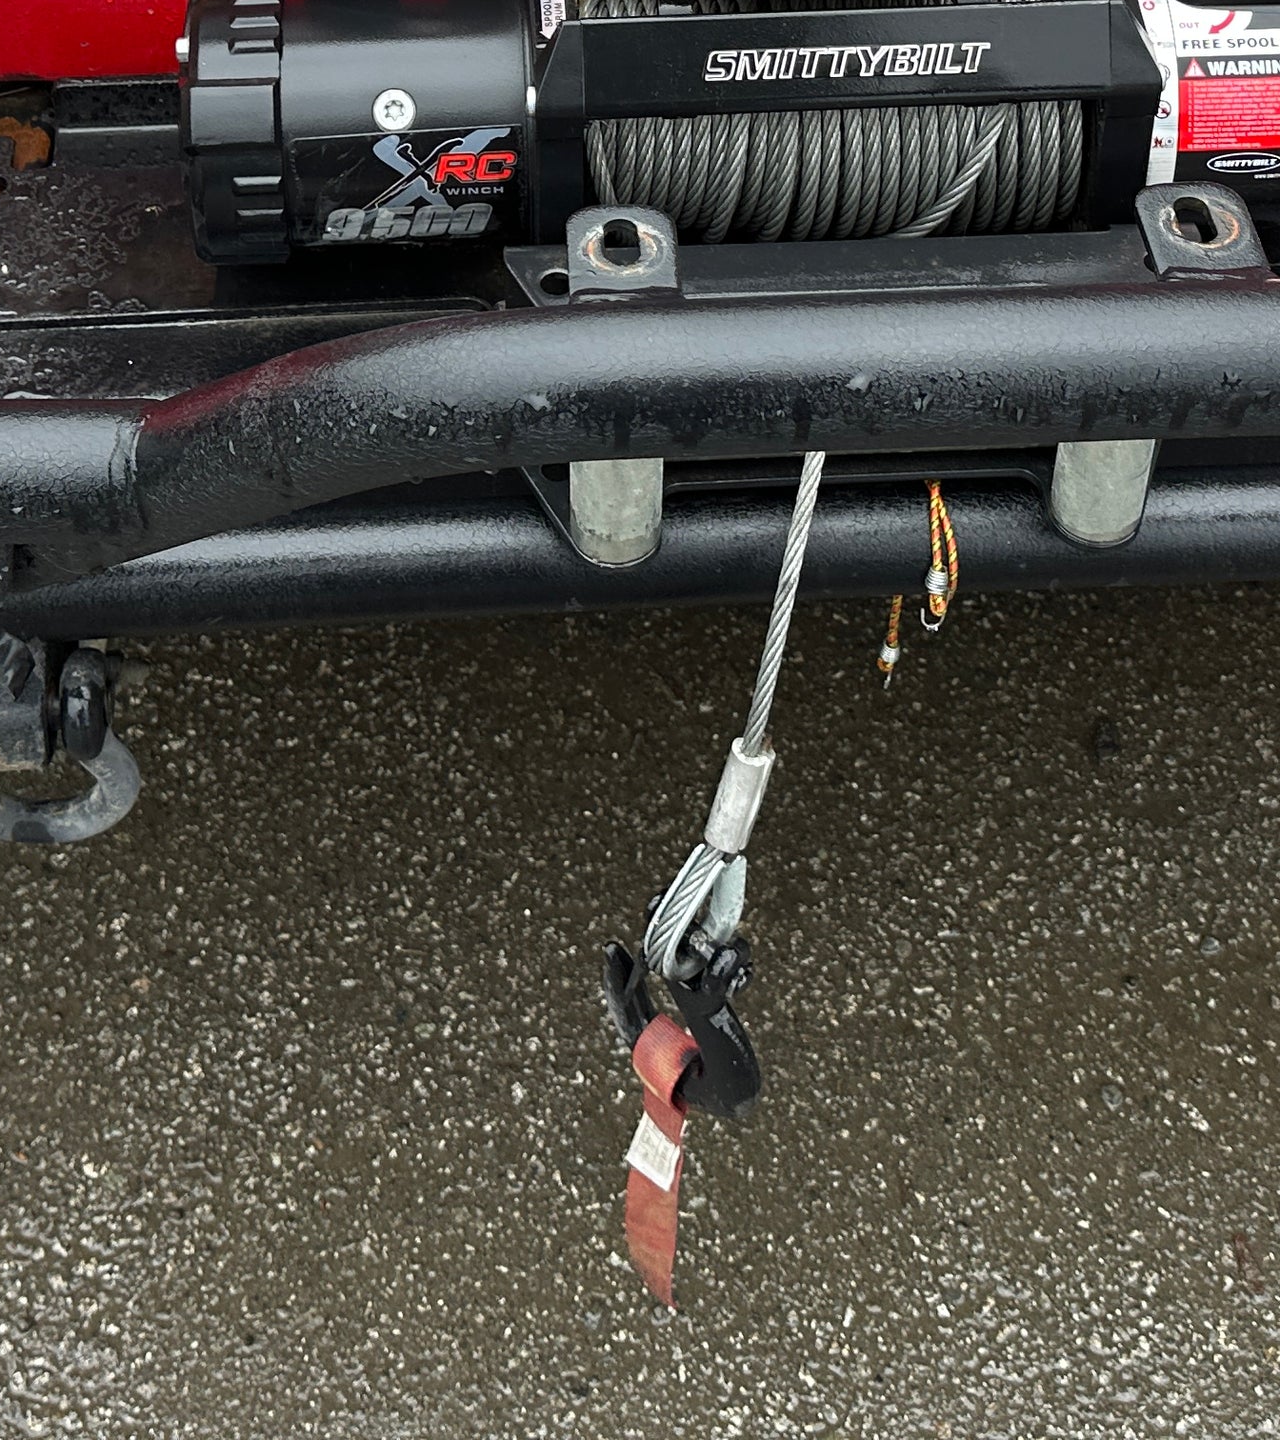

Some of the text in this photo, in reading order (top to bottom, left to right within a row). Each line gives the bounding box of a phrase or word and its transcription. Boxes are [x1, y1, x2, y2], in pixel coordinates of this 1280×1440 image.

[543, 0, 553, 27] SPOOL
[1182, 39, 1221, 50] FREE
[1227, 37, 1280, 48] SPOOL
[703, 42, 991, 82] SMITTYBILT
[446, 186, 505, 196] WINCH
